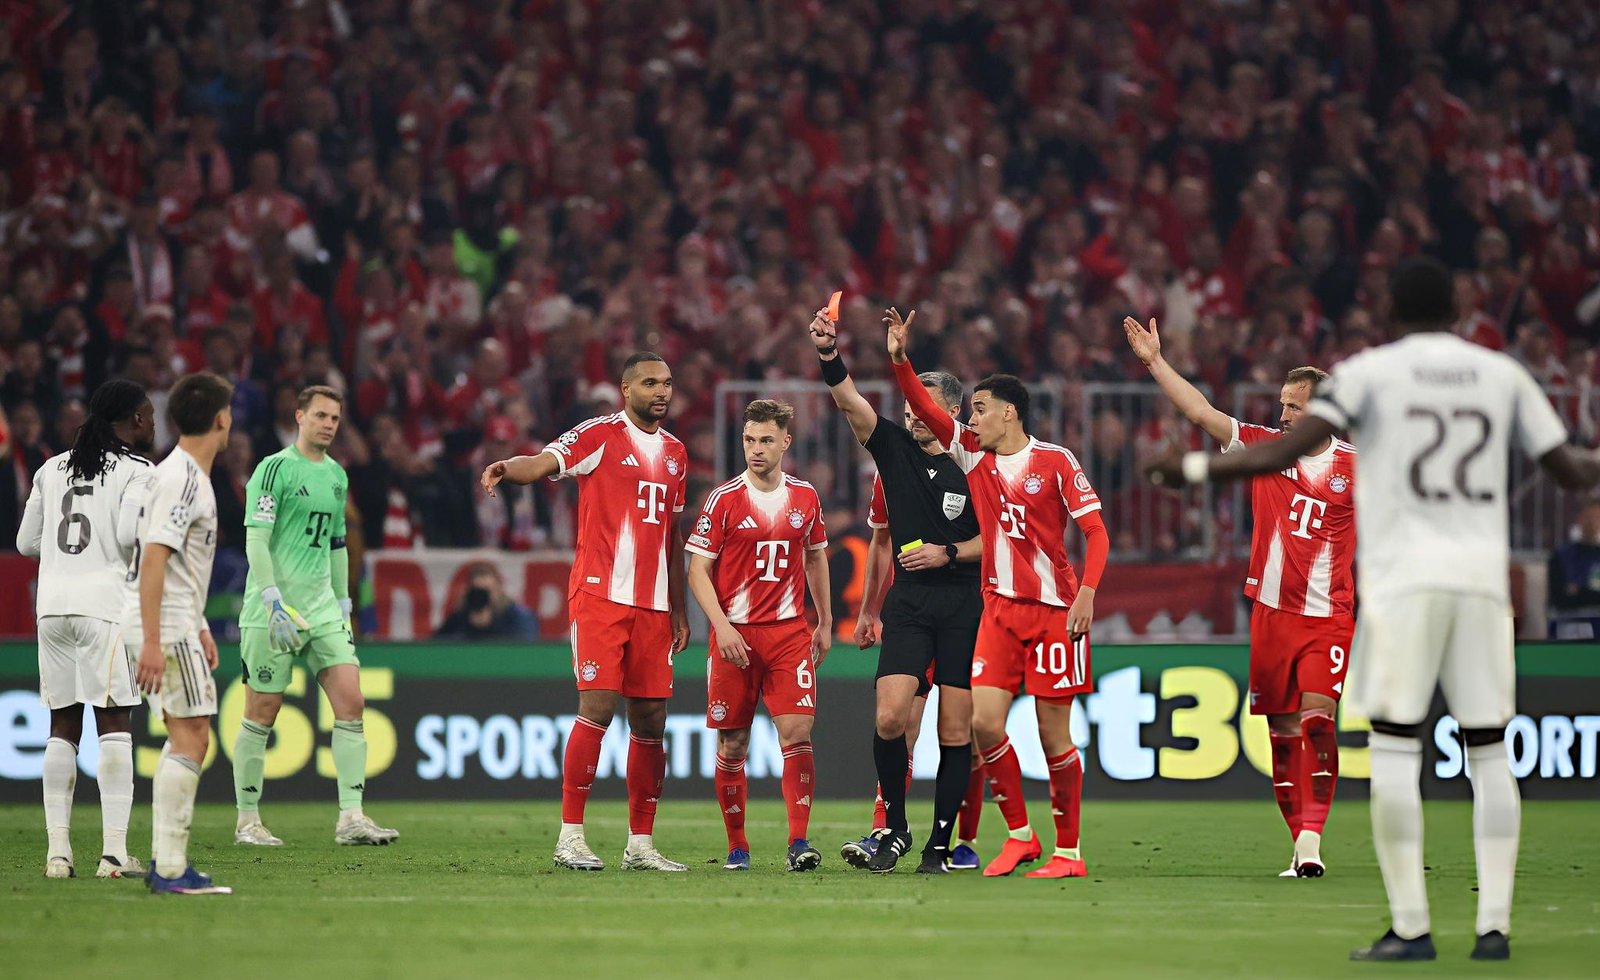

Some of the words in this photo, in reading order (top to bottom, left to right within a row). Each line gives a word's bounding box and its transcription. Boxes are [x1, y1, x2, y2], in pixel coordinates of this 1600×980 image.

[1408, 408, 1494, 499] 22
[57, 486, 94, 555] 6
[796, 659, 813, 689] 6
[1035, 642, 1067, 674] 10
[1330, 645, 1345, 674] 9
[1434, 714, 1600, 779] SORT
